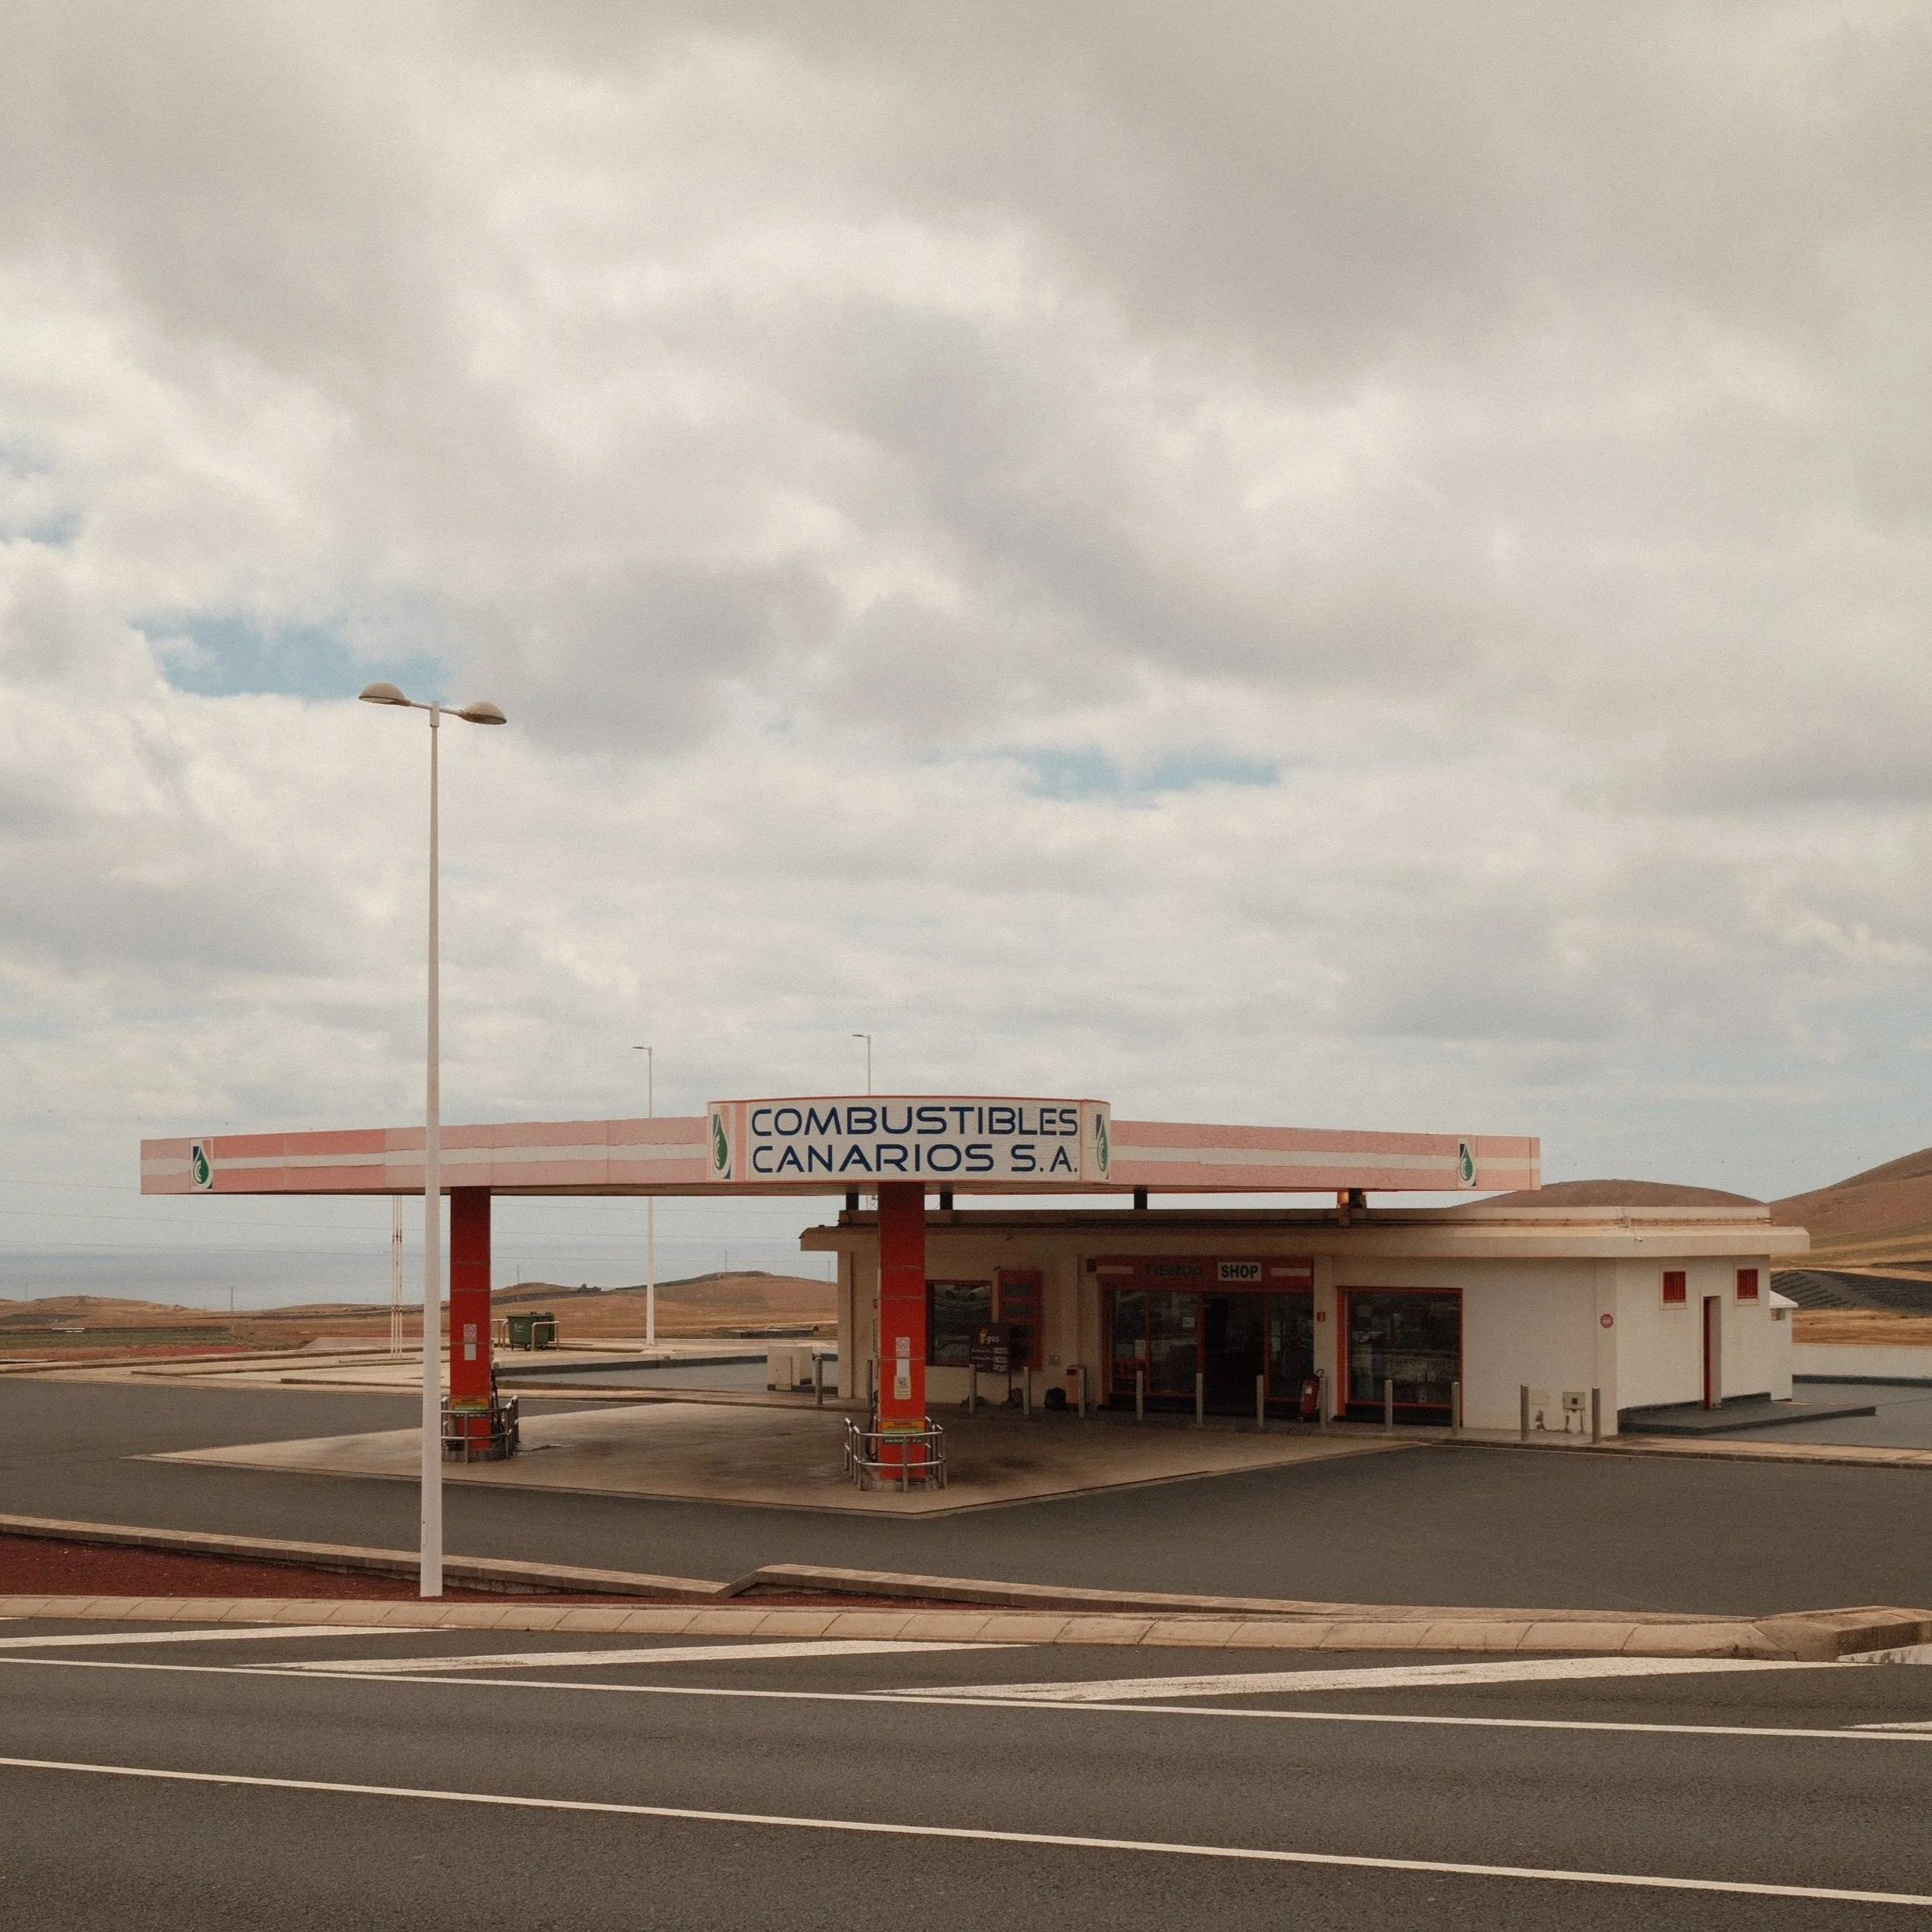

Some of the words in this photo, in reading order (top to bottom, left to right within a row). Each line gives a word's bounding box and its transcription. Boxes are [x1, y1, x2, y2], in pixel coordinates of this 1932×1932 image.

[751, 1106, 1078, 1137] COMBUSTIBLES
[752, 1143, 994, 1174] CANARIOS
[1010, 1144, 1078, 1173] S.A.
[1221, 1264, 1258, 1278] SHOP
